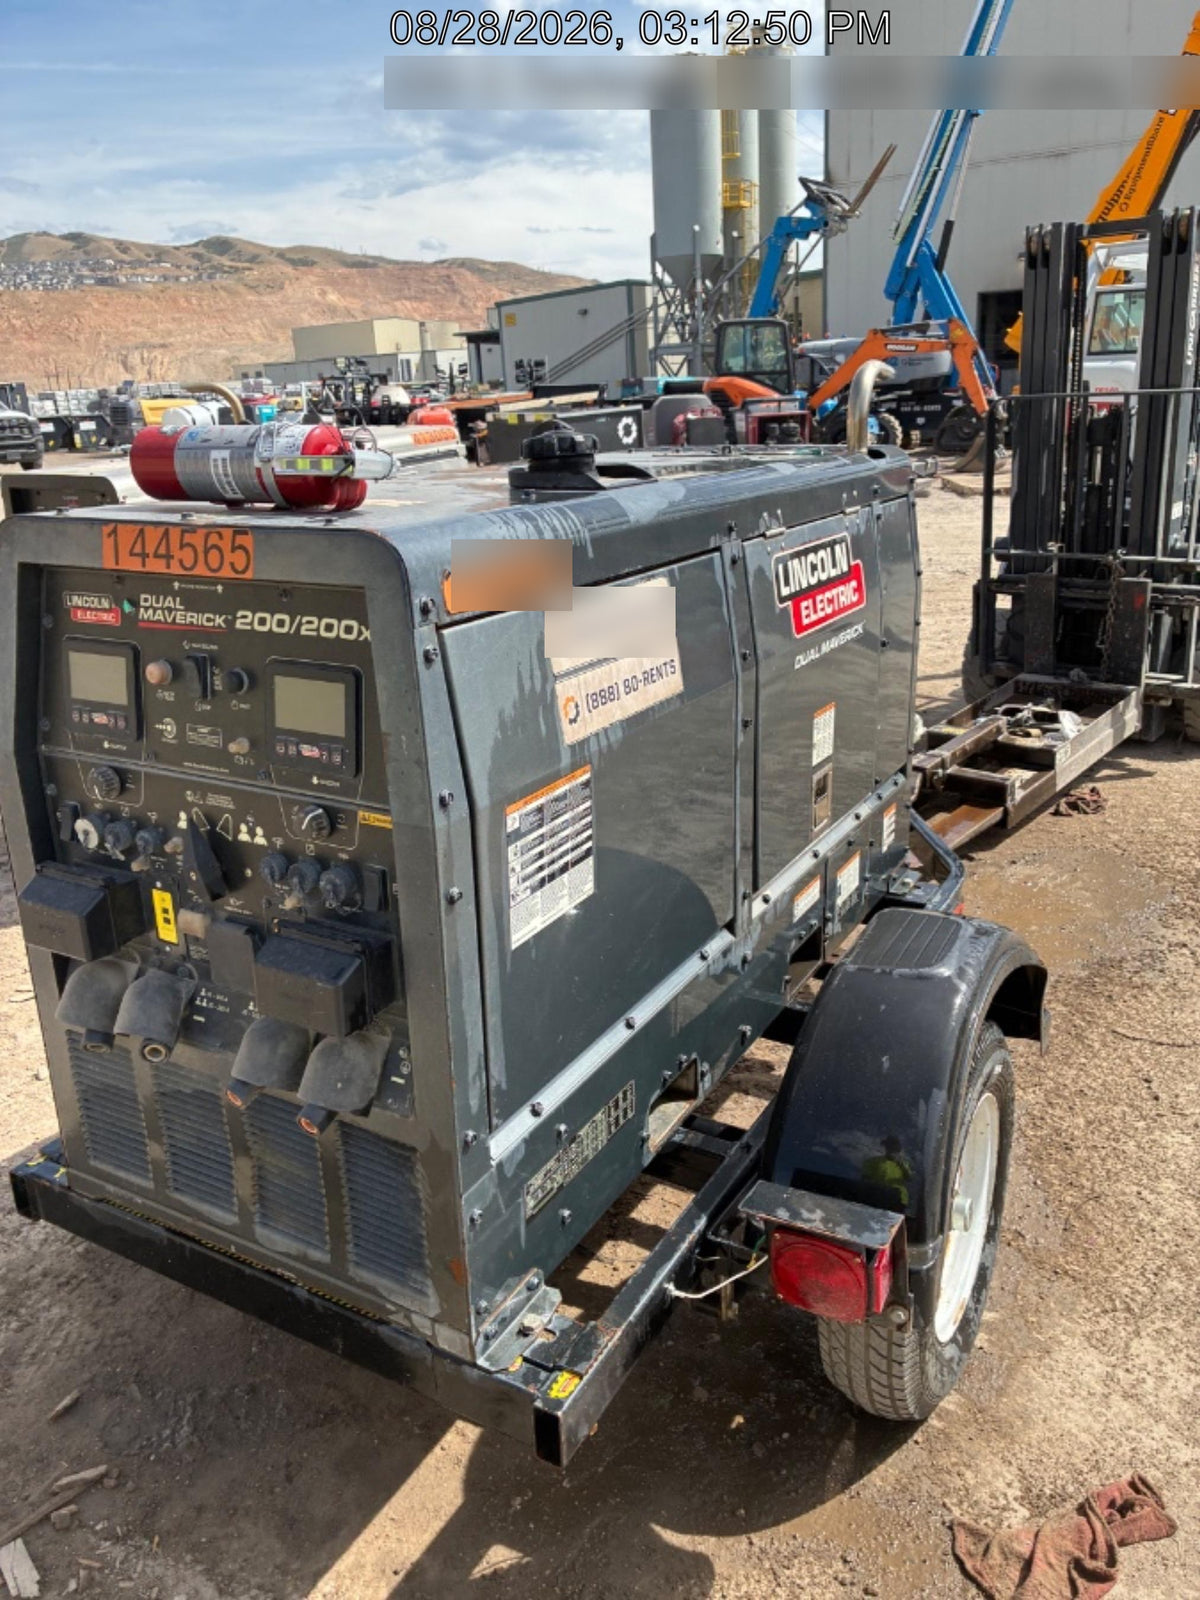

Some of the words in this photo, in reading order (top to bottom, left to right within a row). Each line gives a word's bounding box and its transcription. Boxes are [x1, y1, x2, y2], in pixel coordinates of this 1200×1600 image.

[106, 524, 251, 575] 144565
[778, 542, 849, 597] LINCOLN
[66, 595, 110, 609] LINCOLN
[77, 610, 116, 622] ELECTRIC
[140, 594, 185, 610] DUAL
[801, 580, 859, 626] ELECTRIC
[794, 646, 821, 670] DUAL
[585, 682, 620, 713] (888)
[623, 659, 677, 695] 80-RENTS
